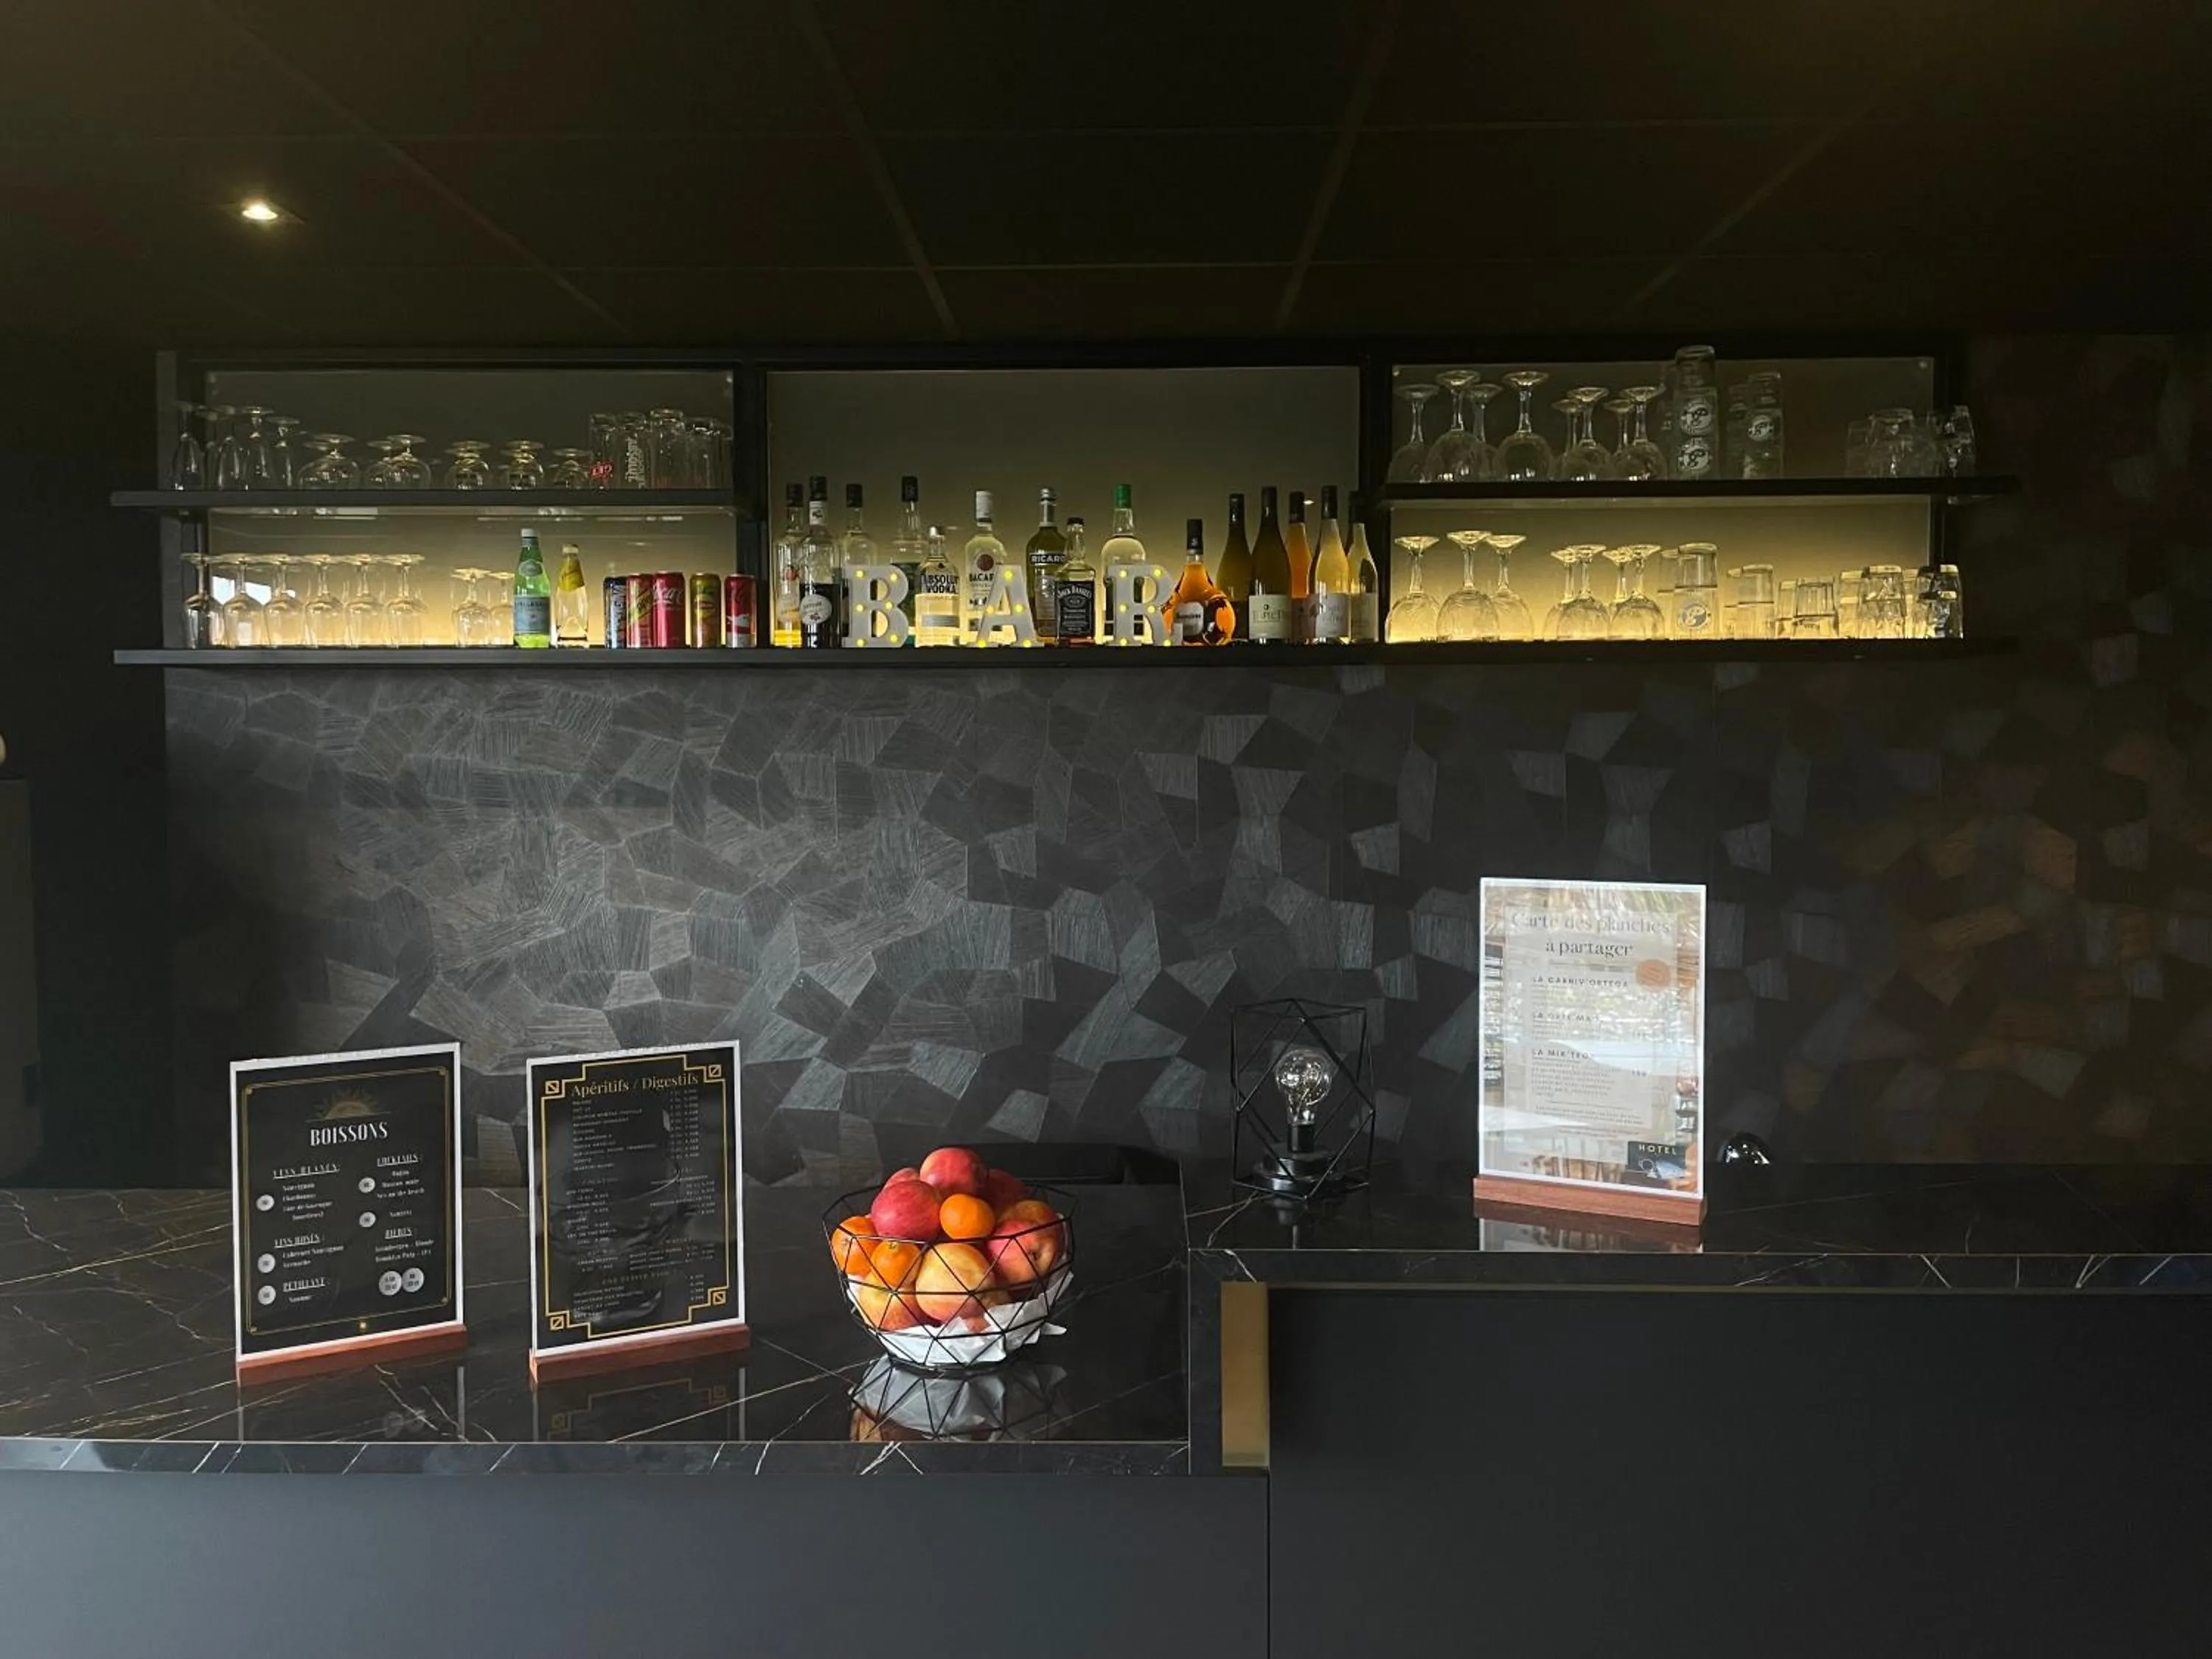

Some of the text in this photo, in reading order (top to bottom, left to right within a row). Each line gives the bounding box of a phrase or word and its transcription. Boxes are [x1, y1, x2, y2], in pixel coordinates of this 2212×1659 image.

[1564, 914, 1593, 931] des
[1597, 917, 1671, 934] planches
[1559, 941, 1634, 959] partager
[571, 1079, 630, 1098] Apéritifs
[641, 1073, 699, 1091] Digestifs
[310, 1121, 388, 1147] BOISSONS
[1638, 1144, 1677, 1155] HOTEL
